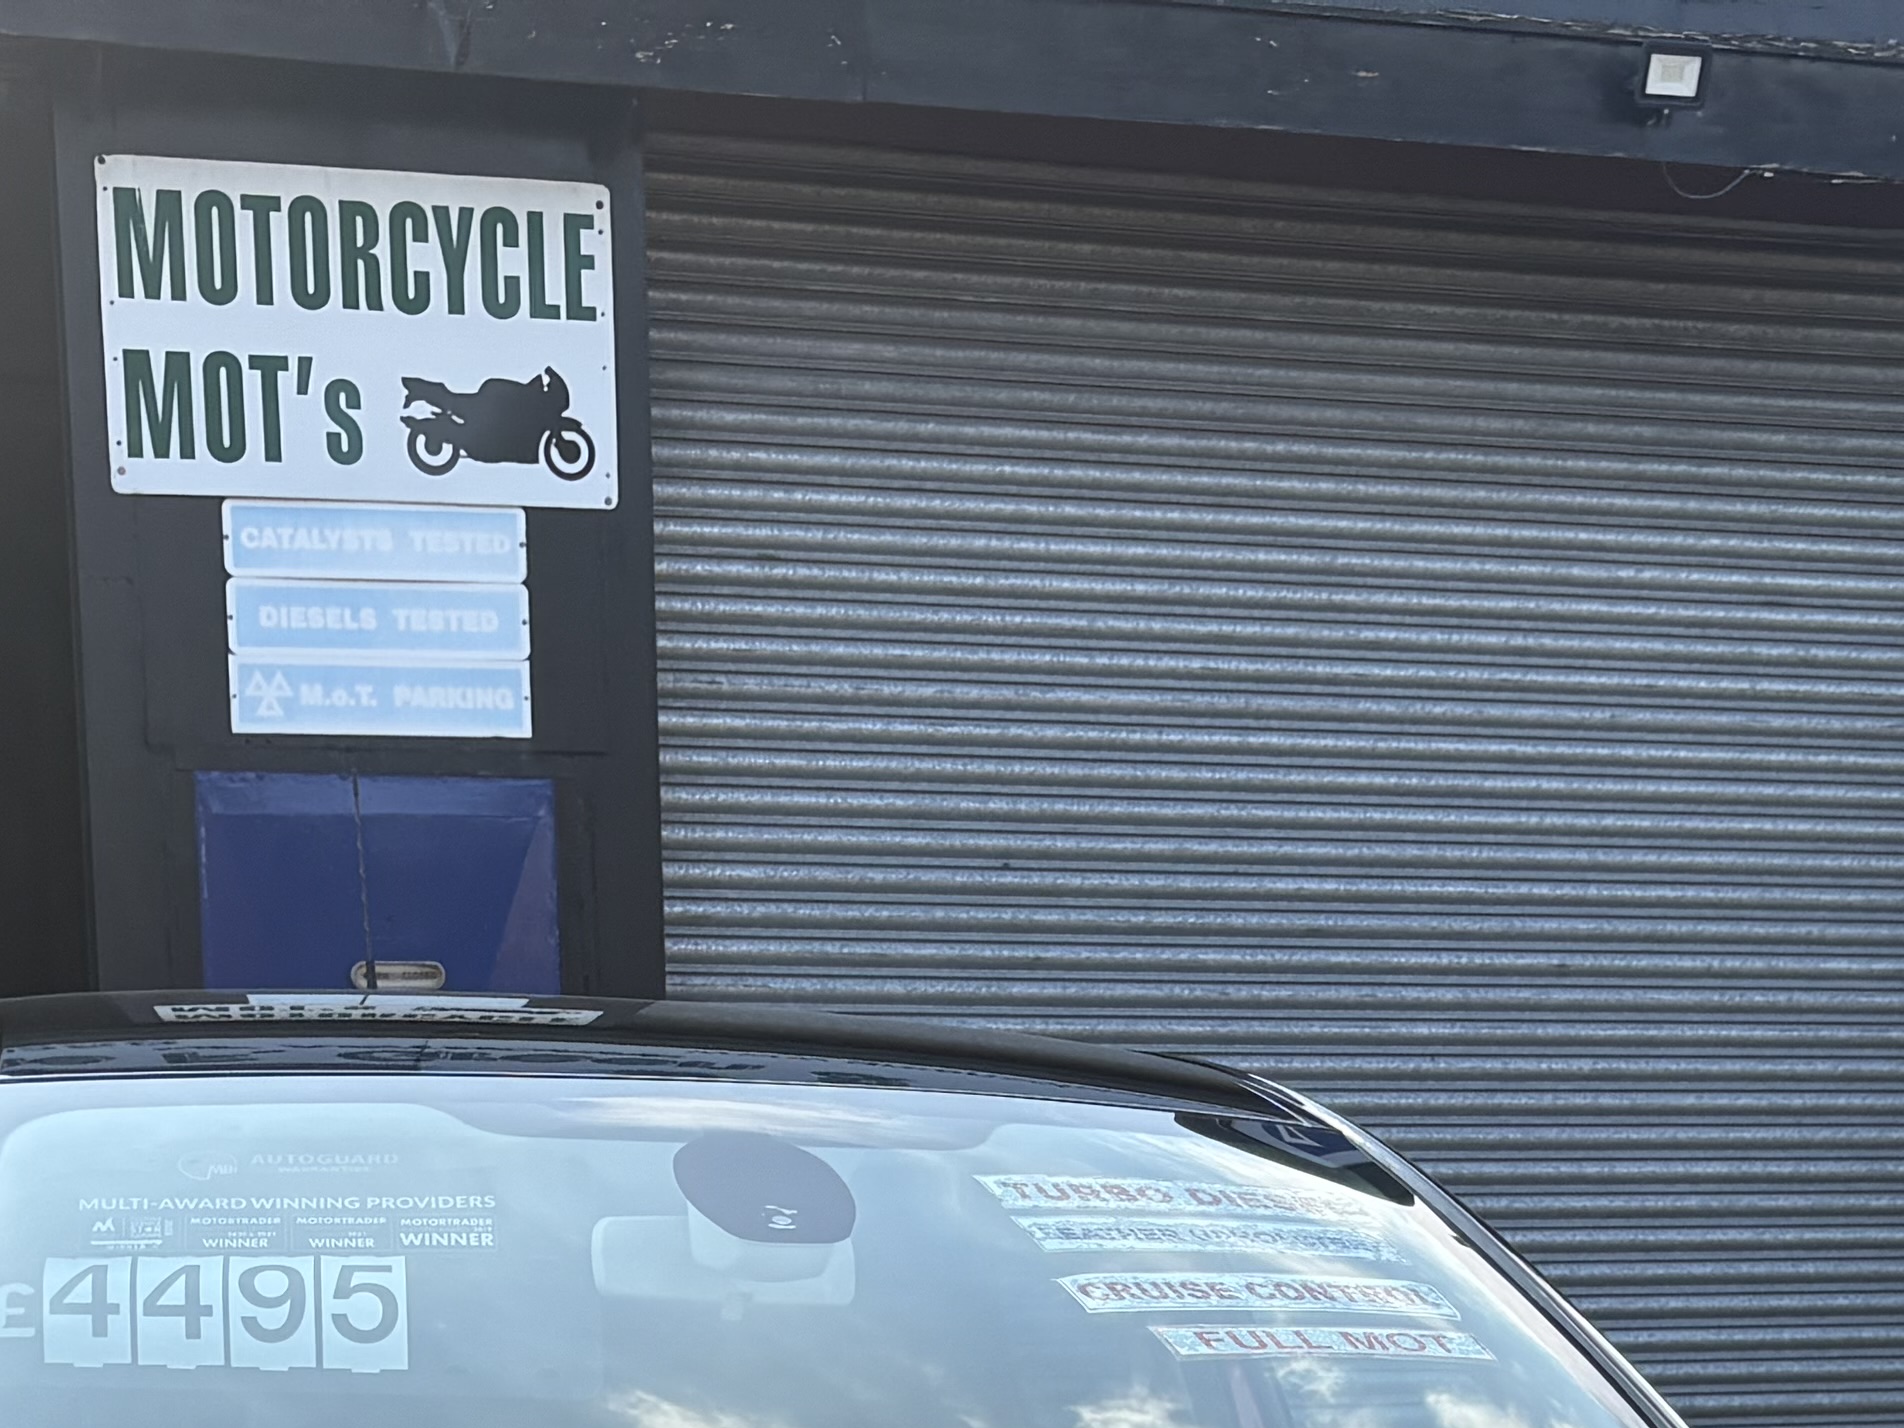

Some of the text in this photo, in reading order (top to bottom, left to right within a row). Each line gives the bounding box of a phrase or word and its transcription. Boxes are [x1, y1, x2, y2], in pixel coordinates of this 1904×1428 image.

[112, 185, 598, 323] MOTORCYCLE
[122, 348, 364, 465] MOT's
[240, 526, 512, 554] CATALYSTS TESTED
[258, 604, 500, 633] DIESELS TESTED
[392, 684, 516, 710] PARKING
[250, 1153, 399, 1165] AUTOGUARD
[78, 1195, 496, 1211] MULTI-AWARD WINNING PROVIDERS
[1001, 1180, 1174, 1204] TURBO
[295, 1216, 387, 1225] MOTORTRADER
[400, 1217, 493, 1227] MOTORTRADER
[202, 1238, 269, 1249] WINNER
[308, 1238, 375, 1248] WINNER
[399, 1232, 495, 1247] WINNER
[1077, 1281, 1446, 1306] CRUISE CONTROL
[1193, 1329, 1456, 1354] FULL MOT
